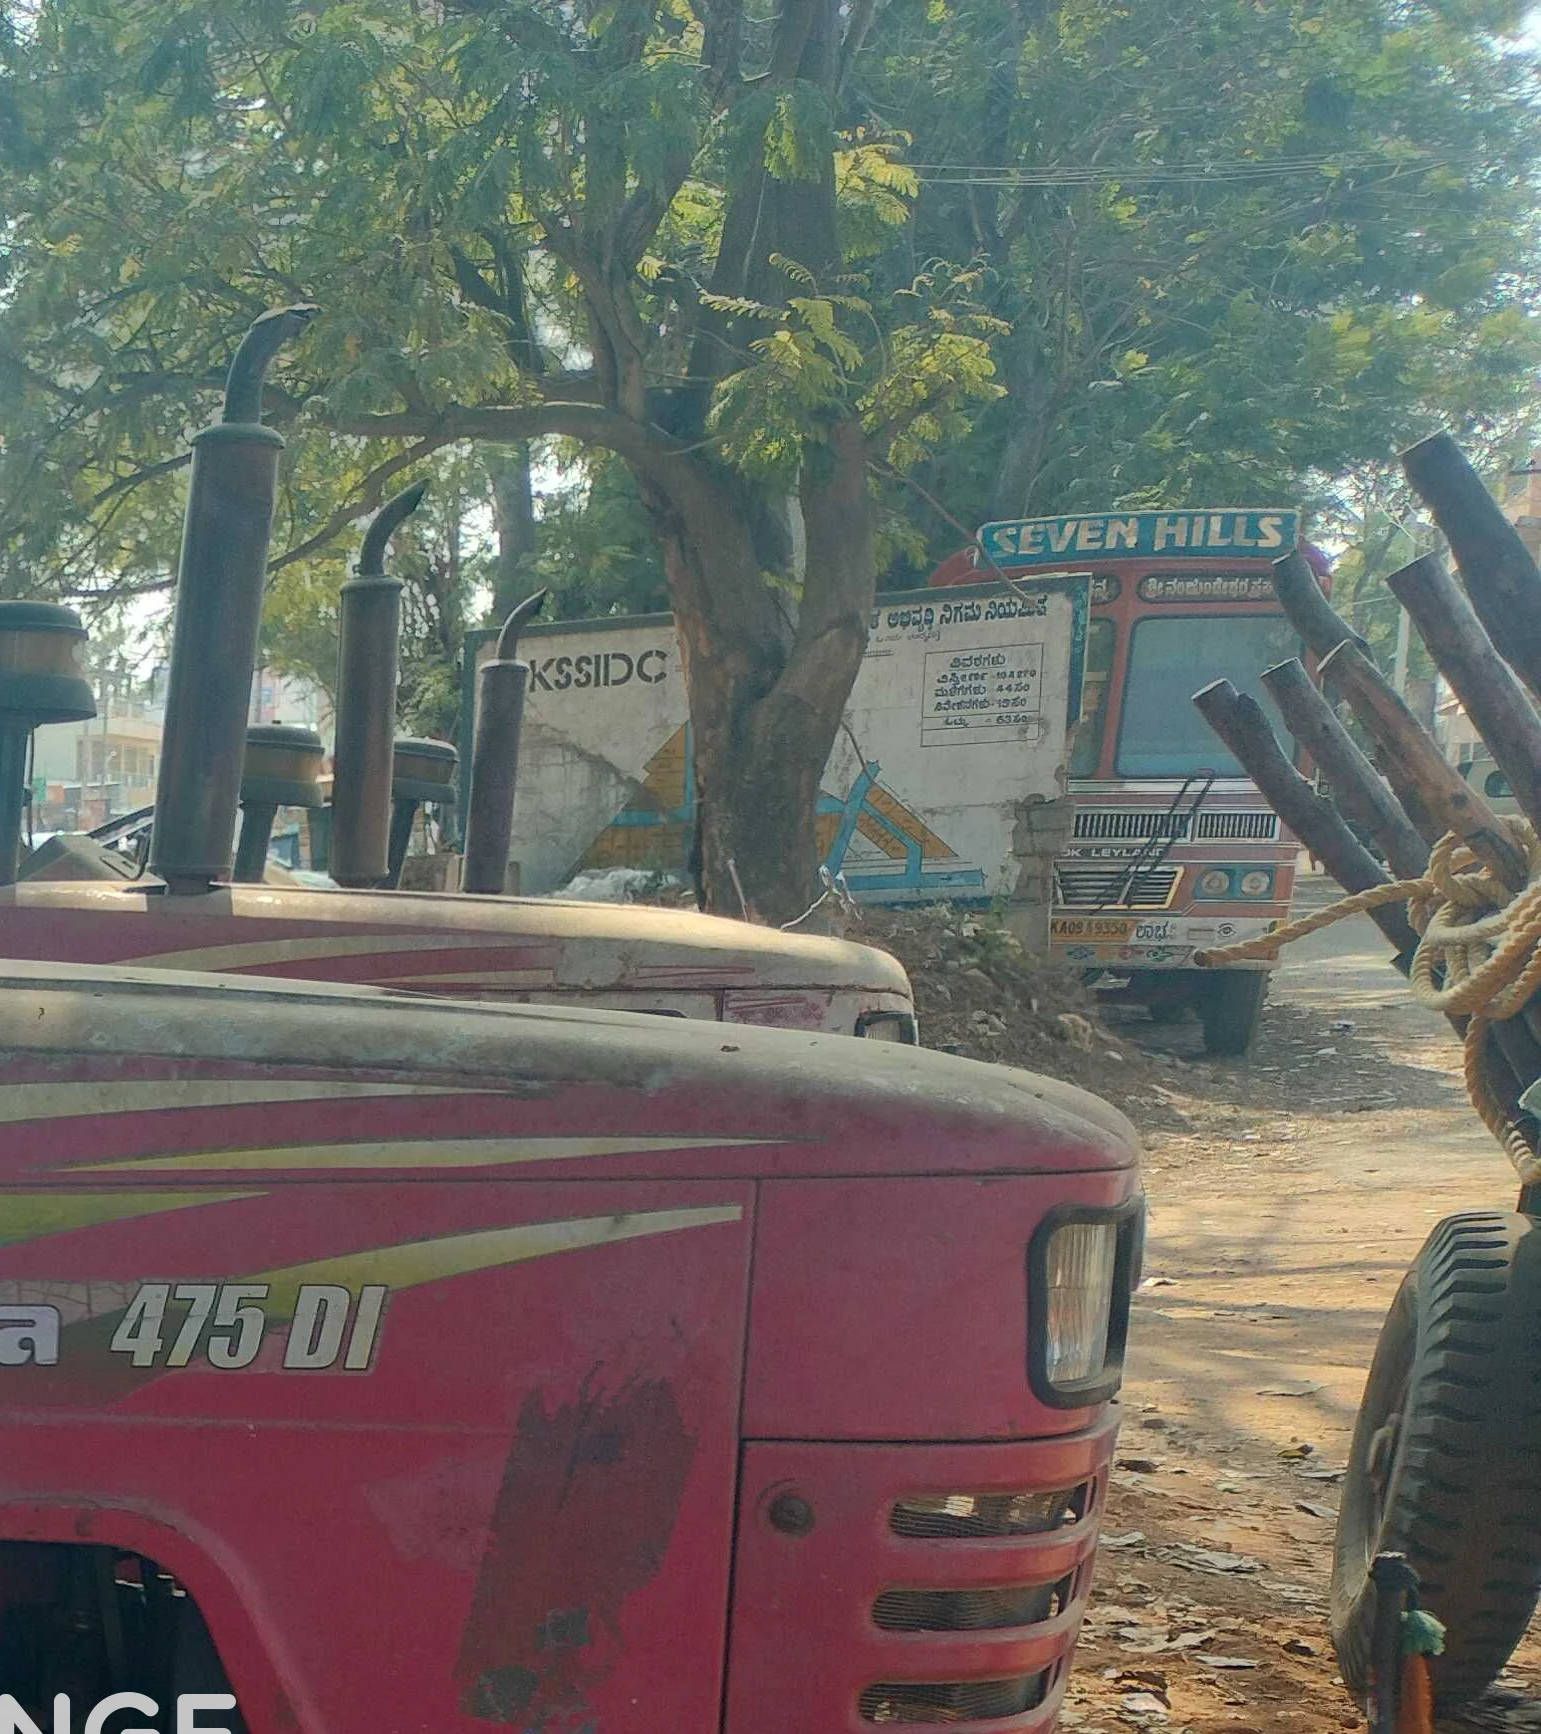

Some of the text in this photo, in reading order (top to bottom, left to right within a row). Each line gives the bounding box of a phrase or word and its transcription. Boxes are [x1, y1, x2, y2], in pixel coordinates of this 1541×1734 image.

[992, 515, 1284, 555] SEVEN HILLS
[939, 602, 982, 625] ನಿಗಮ
[529, 650, 668, 693] KSSIDC
[111, 1283, 269, 1369] 475
[283, 1284, 389, 1371] DI
